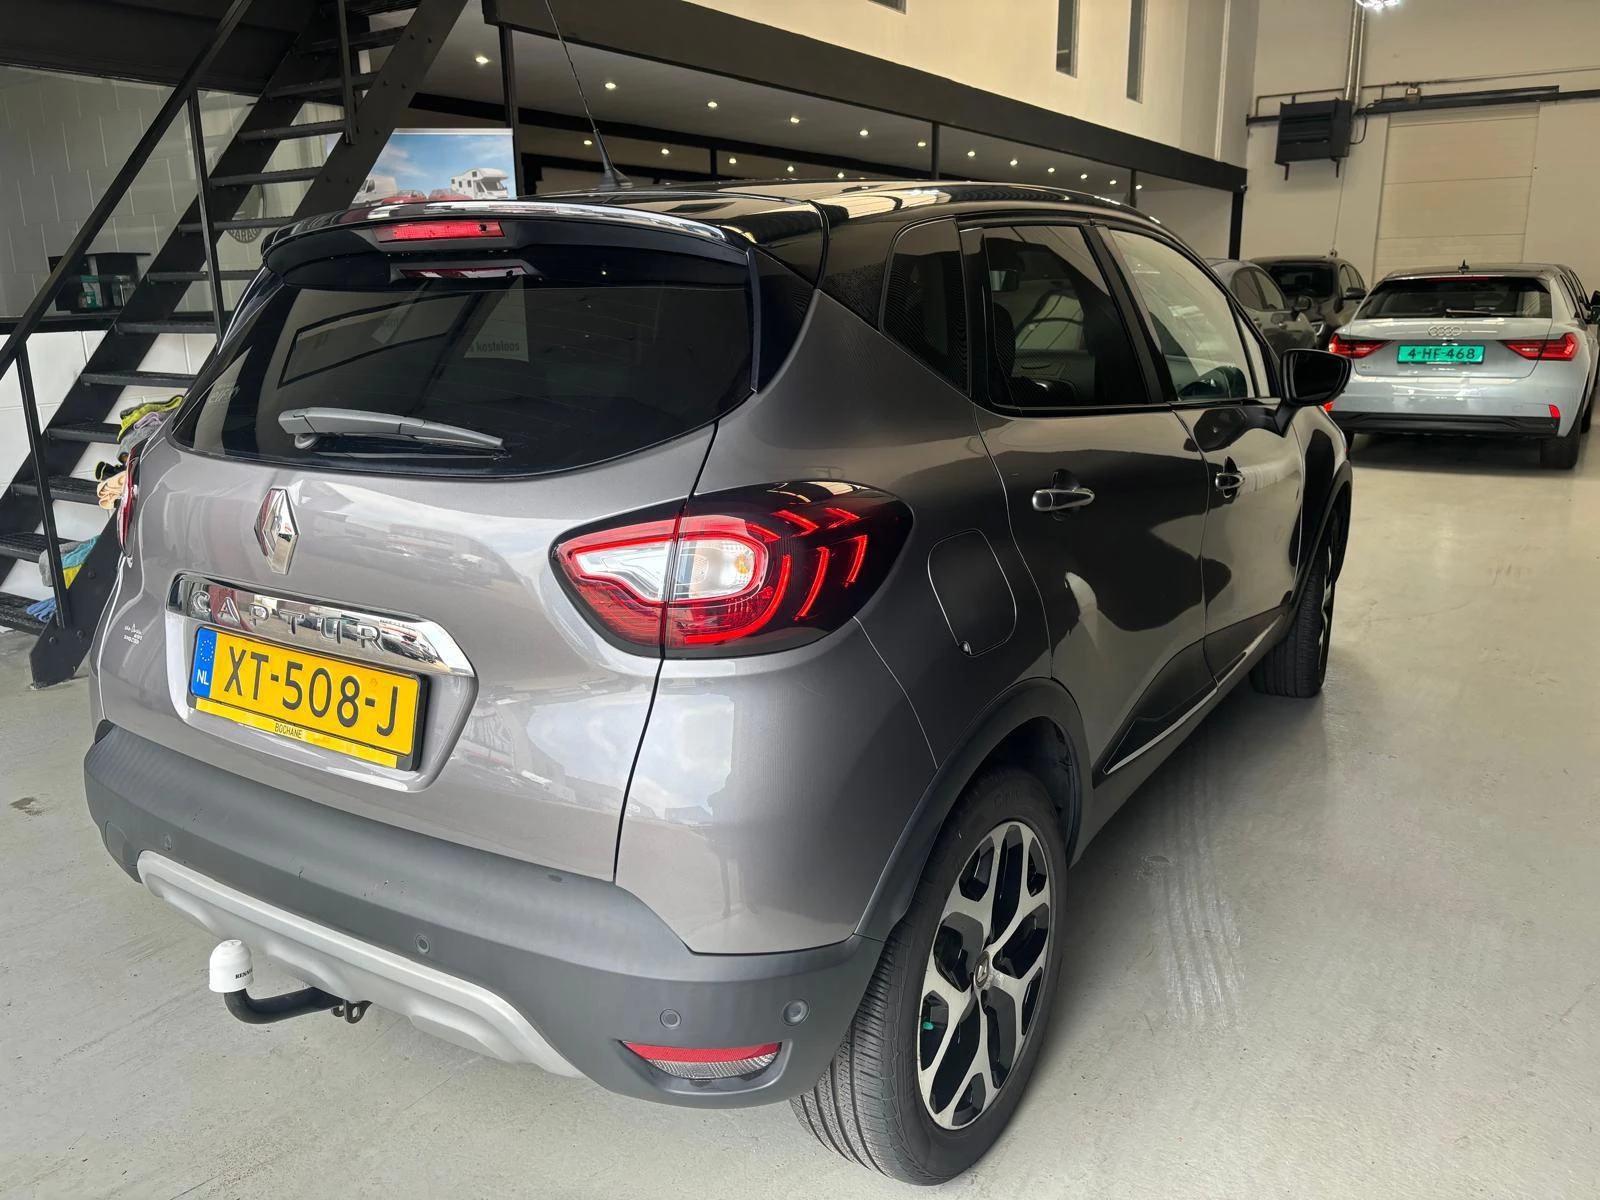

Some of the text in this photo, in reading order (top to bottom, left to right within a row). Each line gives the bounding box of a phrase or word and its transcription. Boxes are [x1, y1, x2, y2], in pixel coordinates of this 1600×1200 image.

[1407, 347, 1476, 360] 4-HF-468
[191, 589, 386, 652] CAPTUR
[196, 668, 210, 687] NL
[223, 645, 399, 737] XT-508-J
[273, 722, 303, 740] BOCHANE
